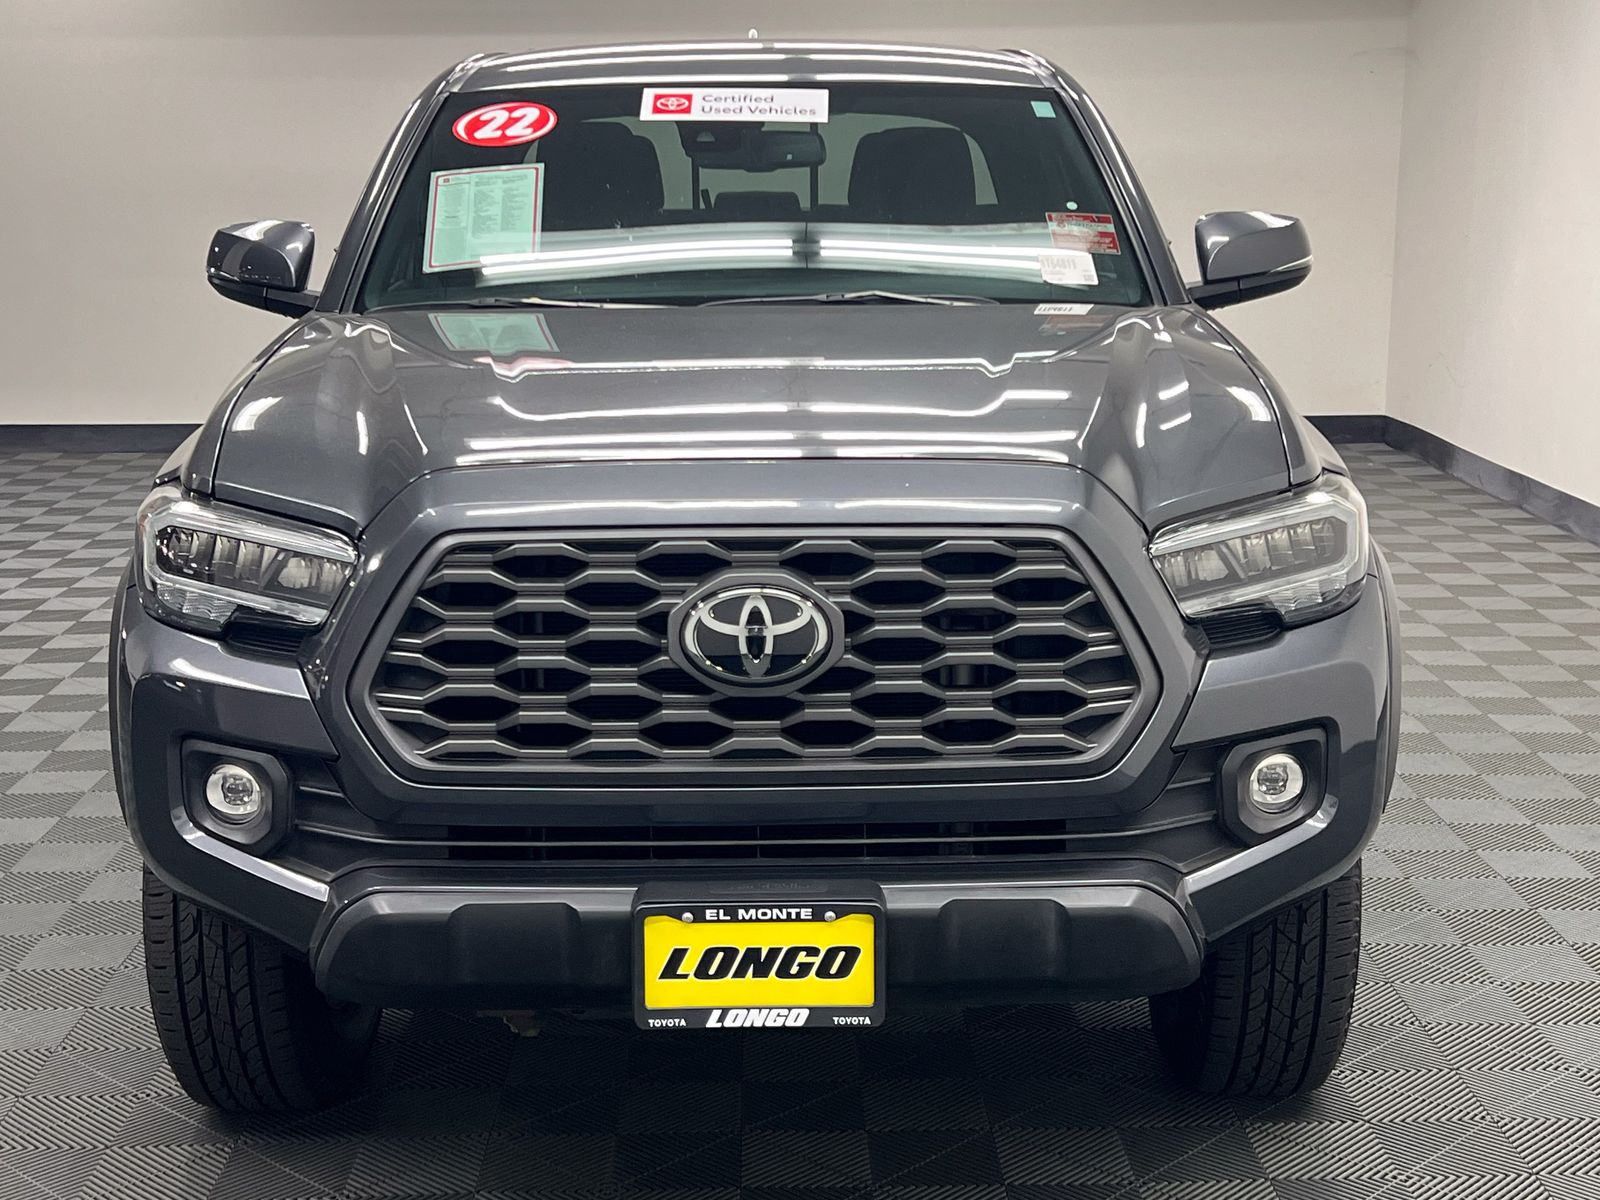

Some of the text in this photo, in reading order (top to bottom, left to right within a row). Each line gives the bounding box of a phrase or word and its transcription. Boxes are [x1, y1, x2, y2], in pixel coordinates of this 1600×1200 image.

[702, 94, 774, 104] Certified
[701, 105, 817, 116] Used Vehicles
[473, 107, 541, 139] 22
[705, 908, 813, 921] EL MONTE
[657, 945, 863, 981] LONGO
[648, 1018, 687, 1028] TOYOTA
[705, 1008, 809, 1028] LONGO
[832, 1016, 871, 1026] TOYOTA
